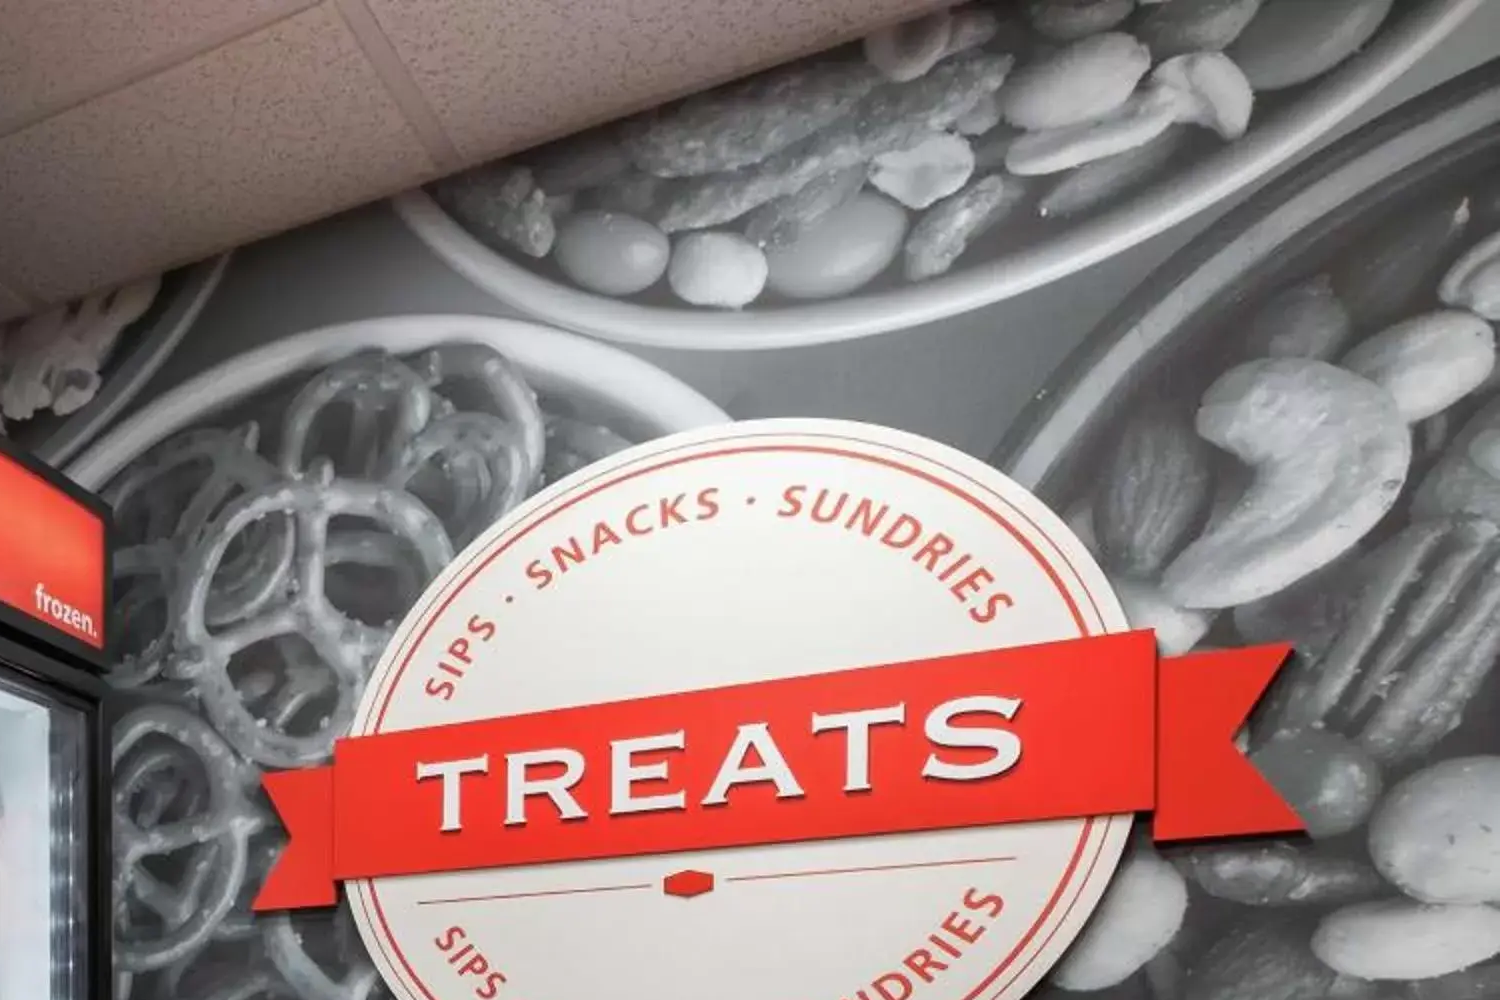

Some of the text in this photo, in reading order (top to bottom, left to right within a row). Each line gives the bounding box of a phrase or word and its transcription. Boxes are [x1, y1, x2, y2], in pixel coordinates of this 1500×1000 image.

[34, 582, 98, 638] frozen.
[424, 483, 1013, 702] SIPS SNACKS SUNDRIES
[415, 695, 1025, 833] TREATS
